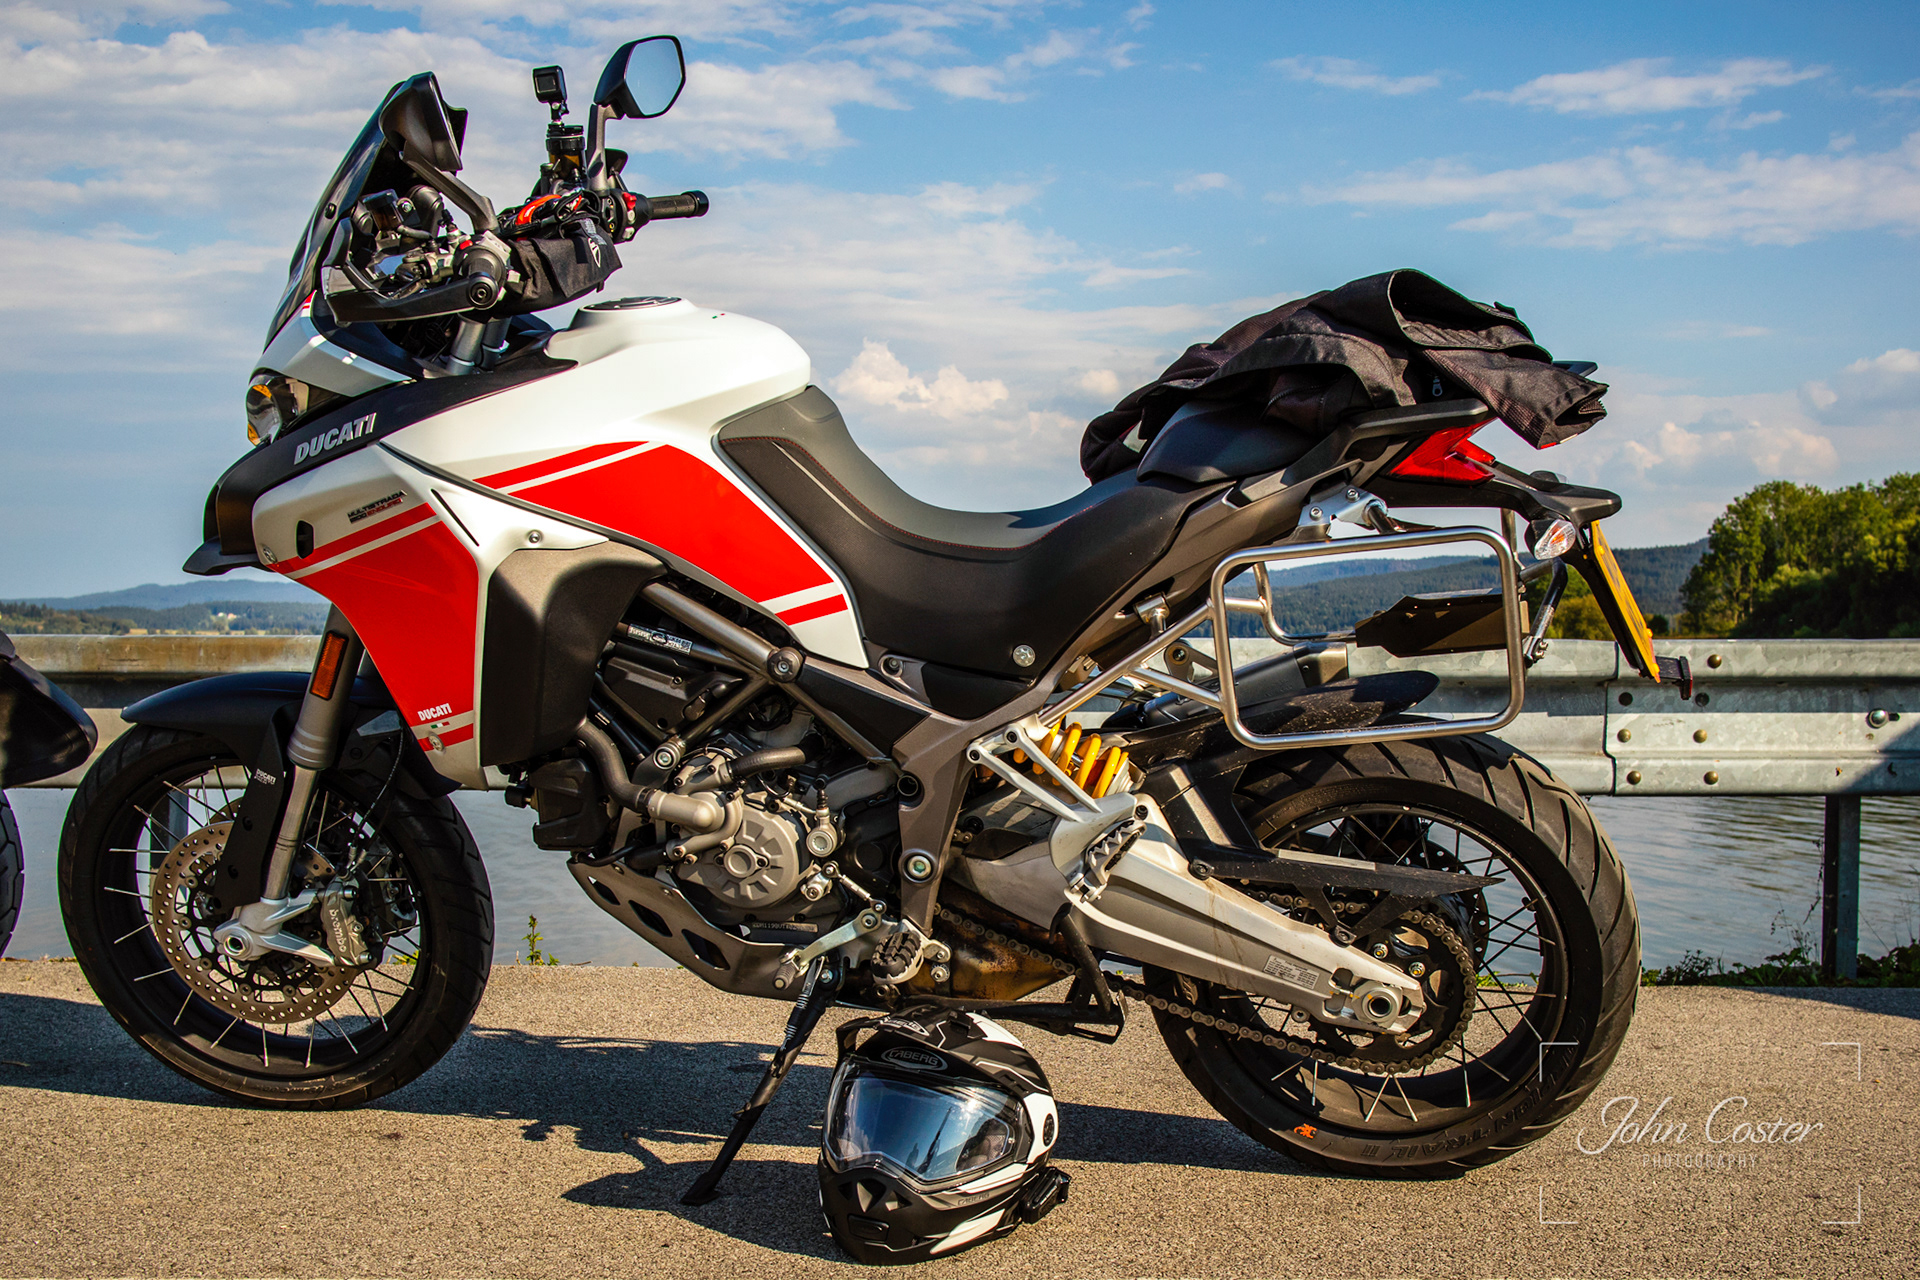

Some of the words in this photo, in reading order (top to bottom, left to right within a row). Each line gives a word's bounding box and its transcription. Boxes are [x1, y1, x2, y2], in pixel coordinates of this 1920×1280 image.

[293, 412, 377, 465] DUCATI
[417, 702, 453, 721] DUCATI
[255, 768, 277, 783] DUCATI
[328, 908, 347, 953] brembo
[889, 1049, 939, 1066] CABERG
